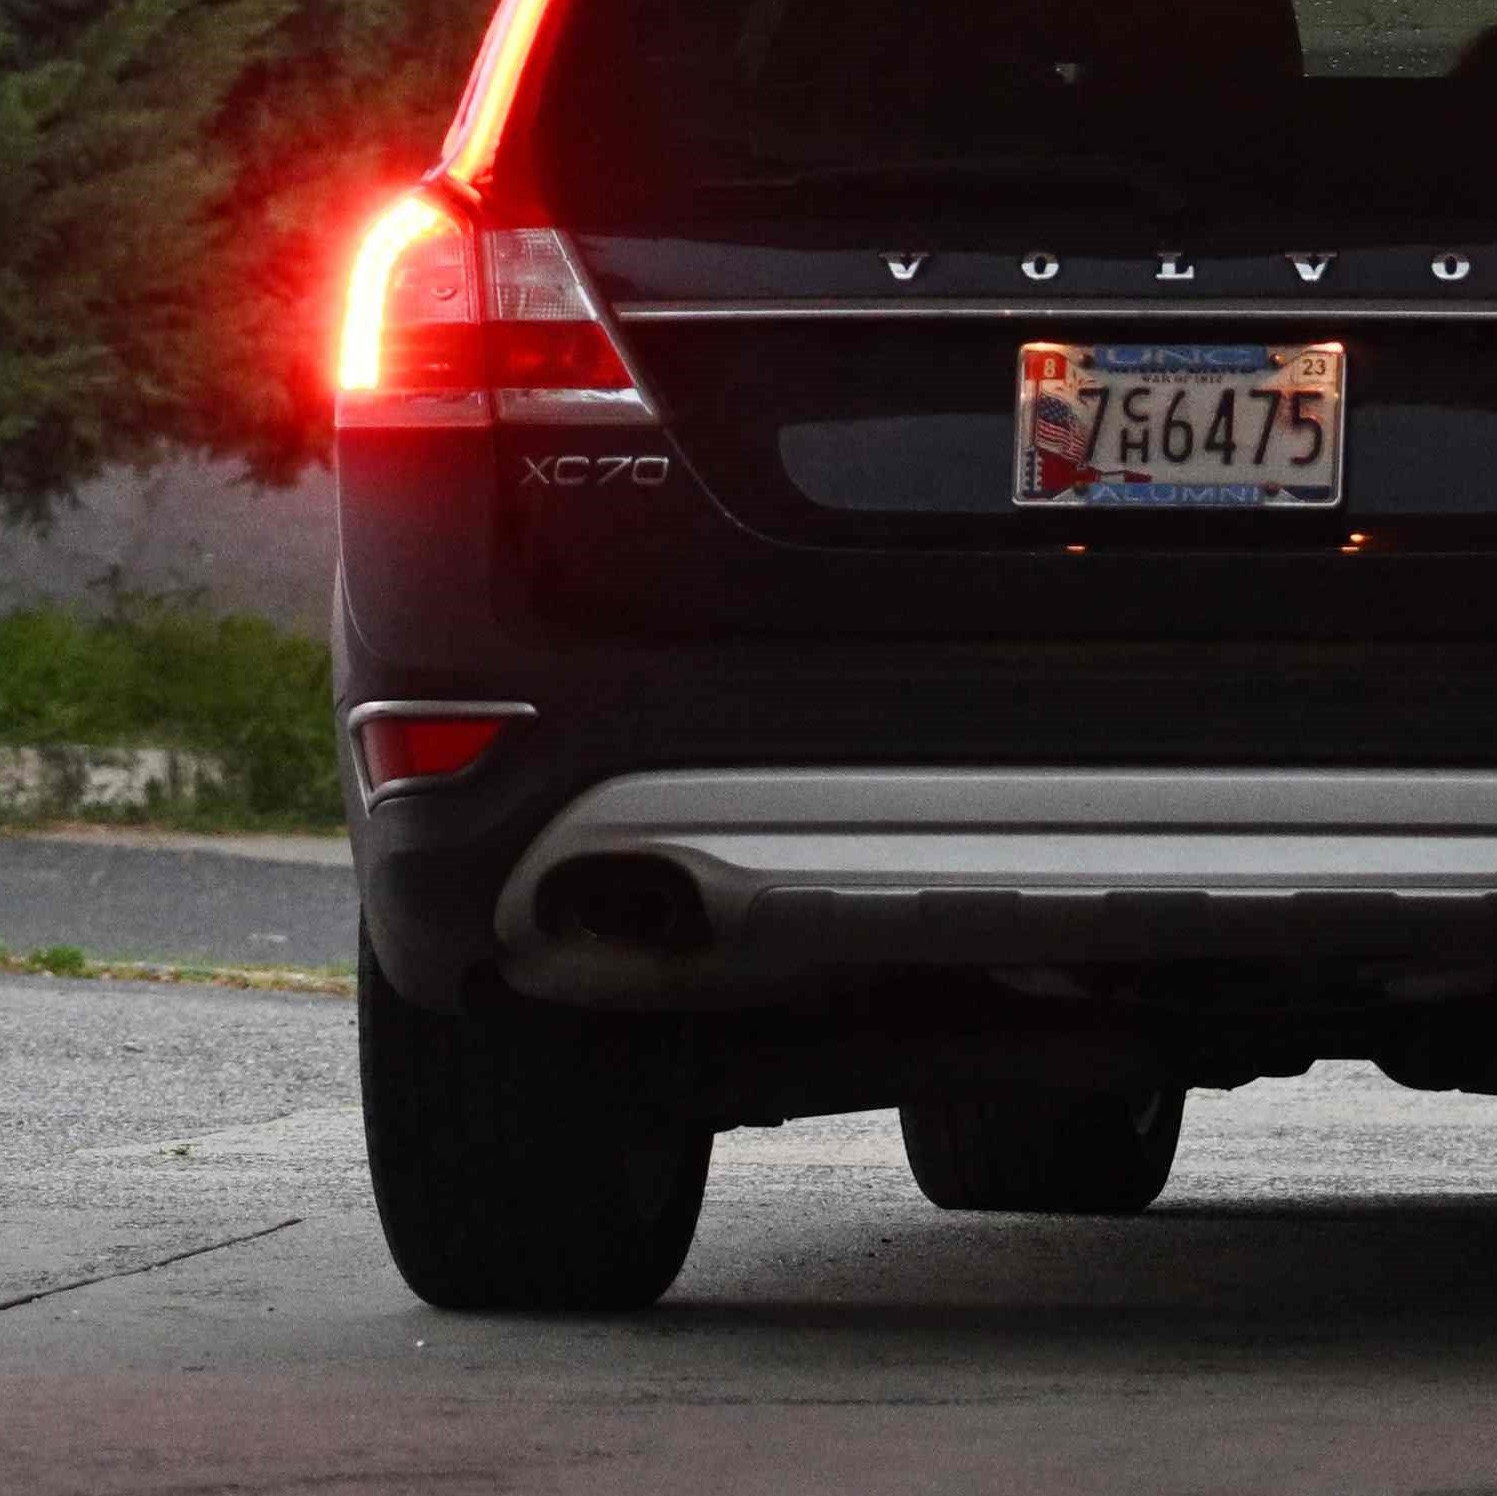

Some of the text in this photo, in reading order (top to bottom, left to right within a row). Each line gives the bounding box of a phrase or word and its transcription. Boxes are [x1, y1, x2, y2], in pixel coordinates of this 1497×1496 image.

[877, 250, 1472, 282] VOLVO
[1042, 358, 1056, 377] 8
[1302, 358, 1326, 375] 23
[518, 455, 669, 486] XC70
[1091, 486, 1259, 503] ALUMNI
